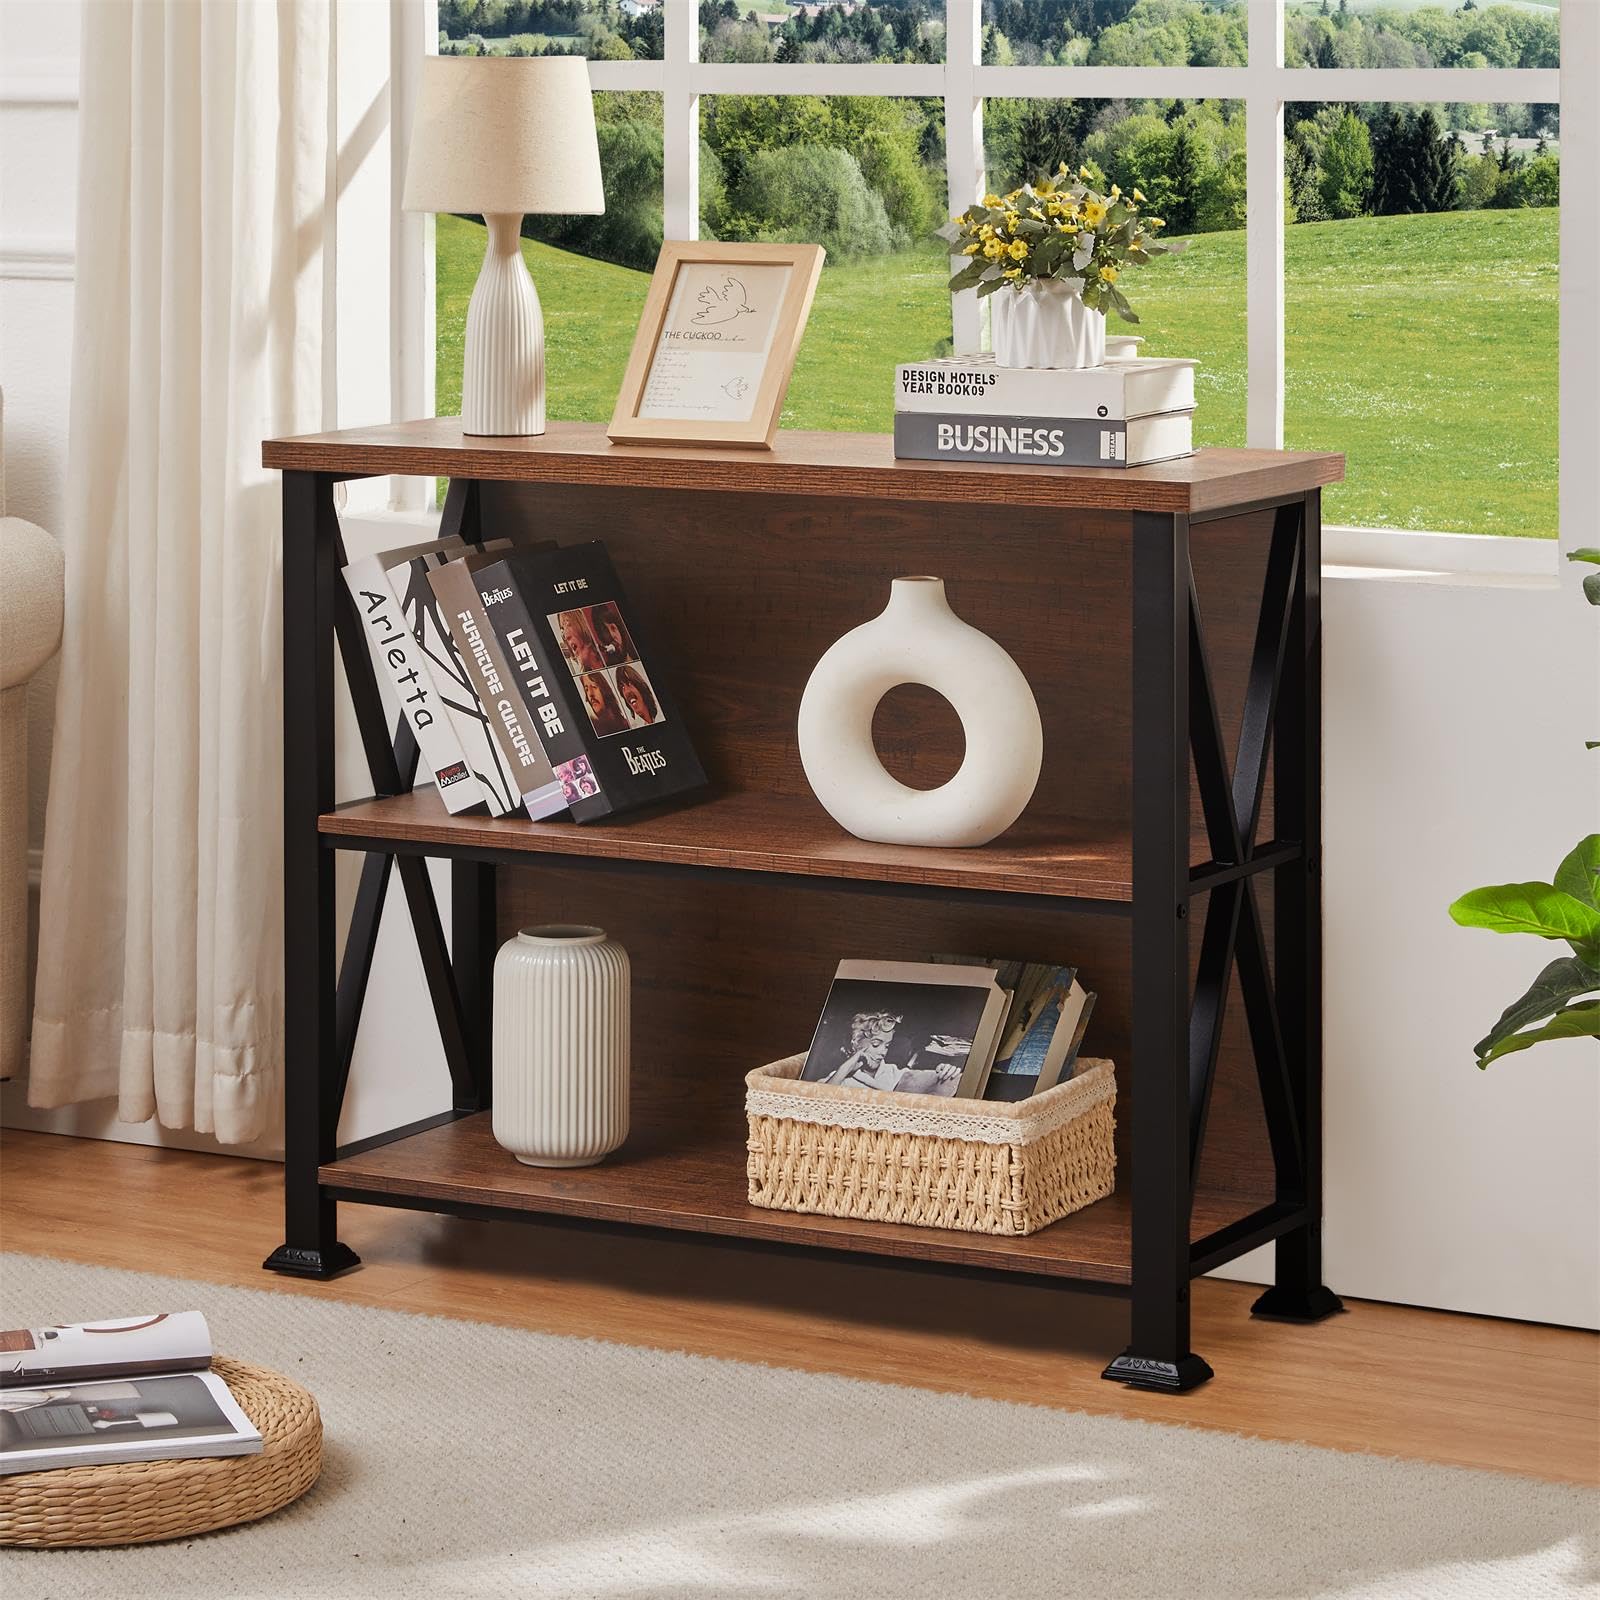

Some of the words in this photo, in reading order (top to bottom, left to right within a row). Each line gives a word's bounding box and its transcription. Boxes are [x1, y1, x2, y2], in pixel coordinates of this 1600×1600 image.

[664, 331, 681, 339] THE
[683, 331, 722, 340] CUCKOO
[902, 370, 946, 383] DESIGN
[950, 372, 996, 385] HOTELS
[902, 382, 933, 394] YEAR
[937, 423, 1066, 457] BUSINESS
[553, 582, 568, 594] LET
[567, 580, 577, 591] IT
[576, 578, 589, 590] BE
[359, 591, 433, 730] Arletta
[505, 627, 539, 672] LET
[526, 676, 550, 698] IT
[497, 699, 536, 767] CULTURE
[537, 702, 565, 738] BE
